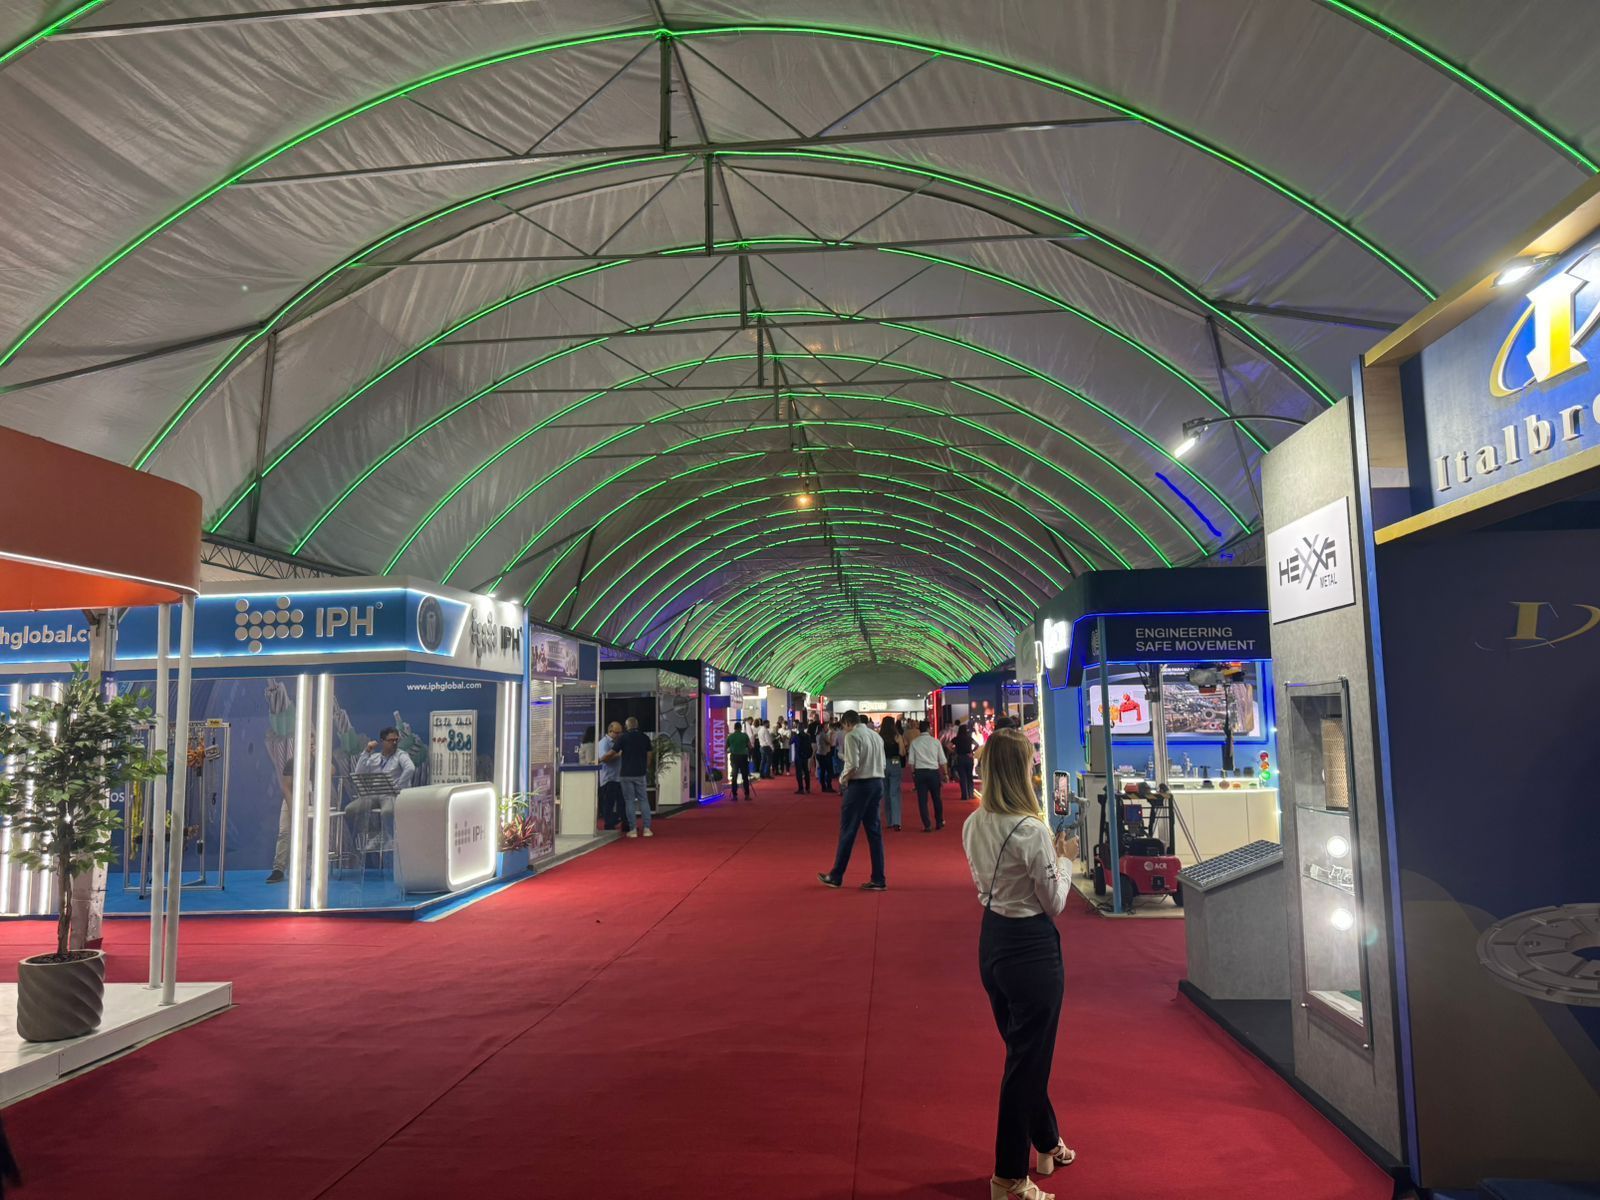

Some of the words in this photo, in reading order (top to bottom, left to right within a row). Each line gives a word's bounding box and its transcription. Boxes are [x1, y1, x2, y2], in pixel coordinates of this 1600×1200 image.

[1320, 573, 1338, 588] METAL
[315, 606, 374, 637] IPH
[0, 624, 118, 650] hglobal.c
[500, 625, 520, 651] IPH
[1136, 627, 1233, 639] ENGINEERING
[1136, 641, 1172, 652] SAFE
[1175, 640, 1256, 651] MOVEMENT
[407, 681, 482, 692] www.iphglobal.com
